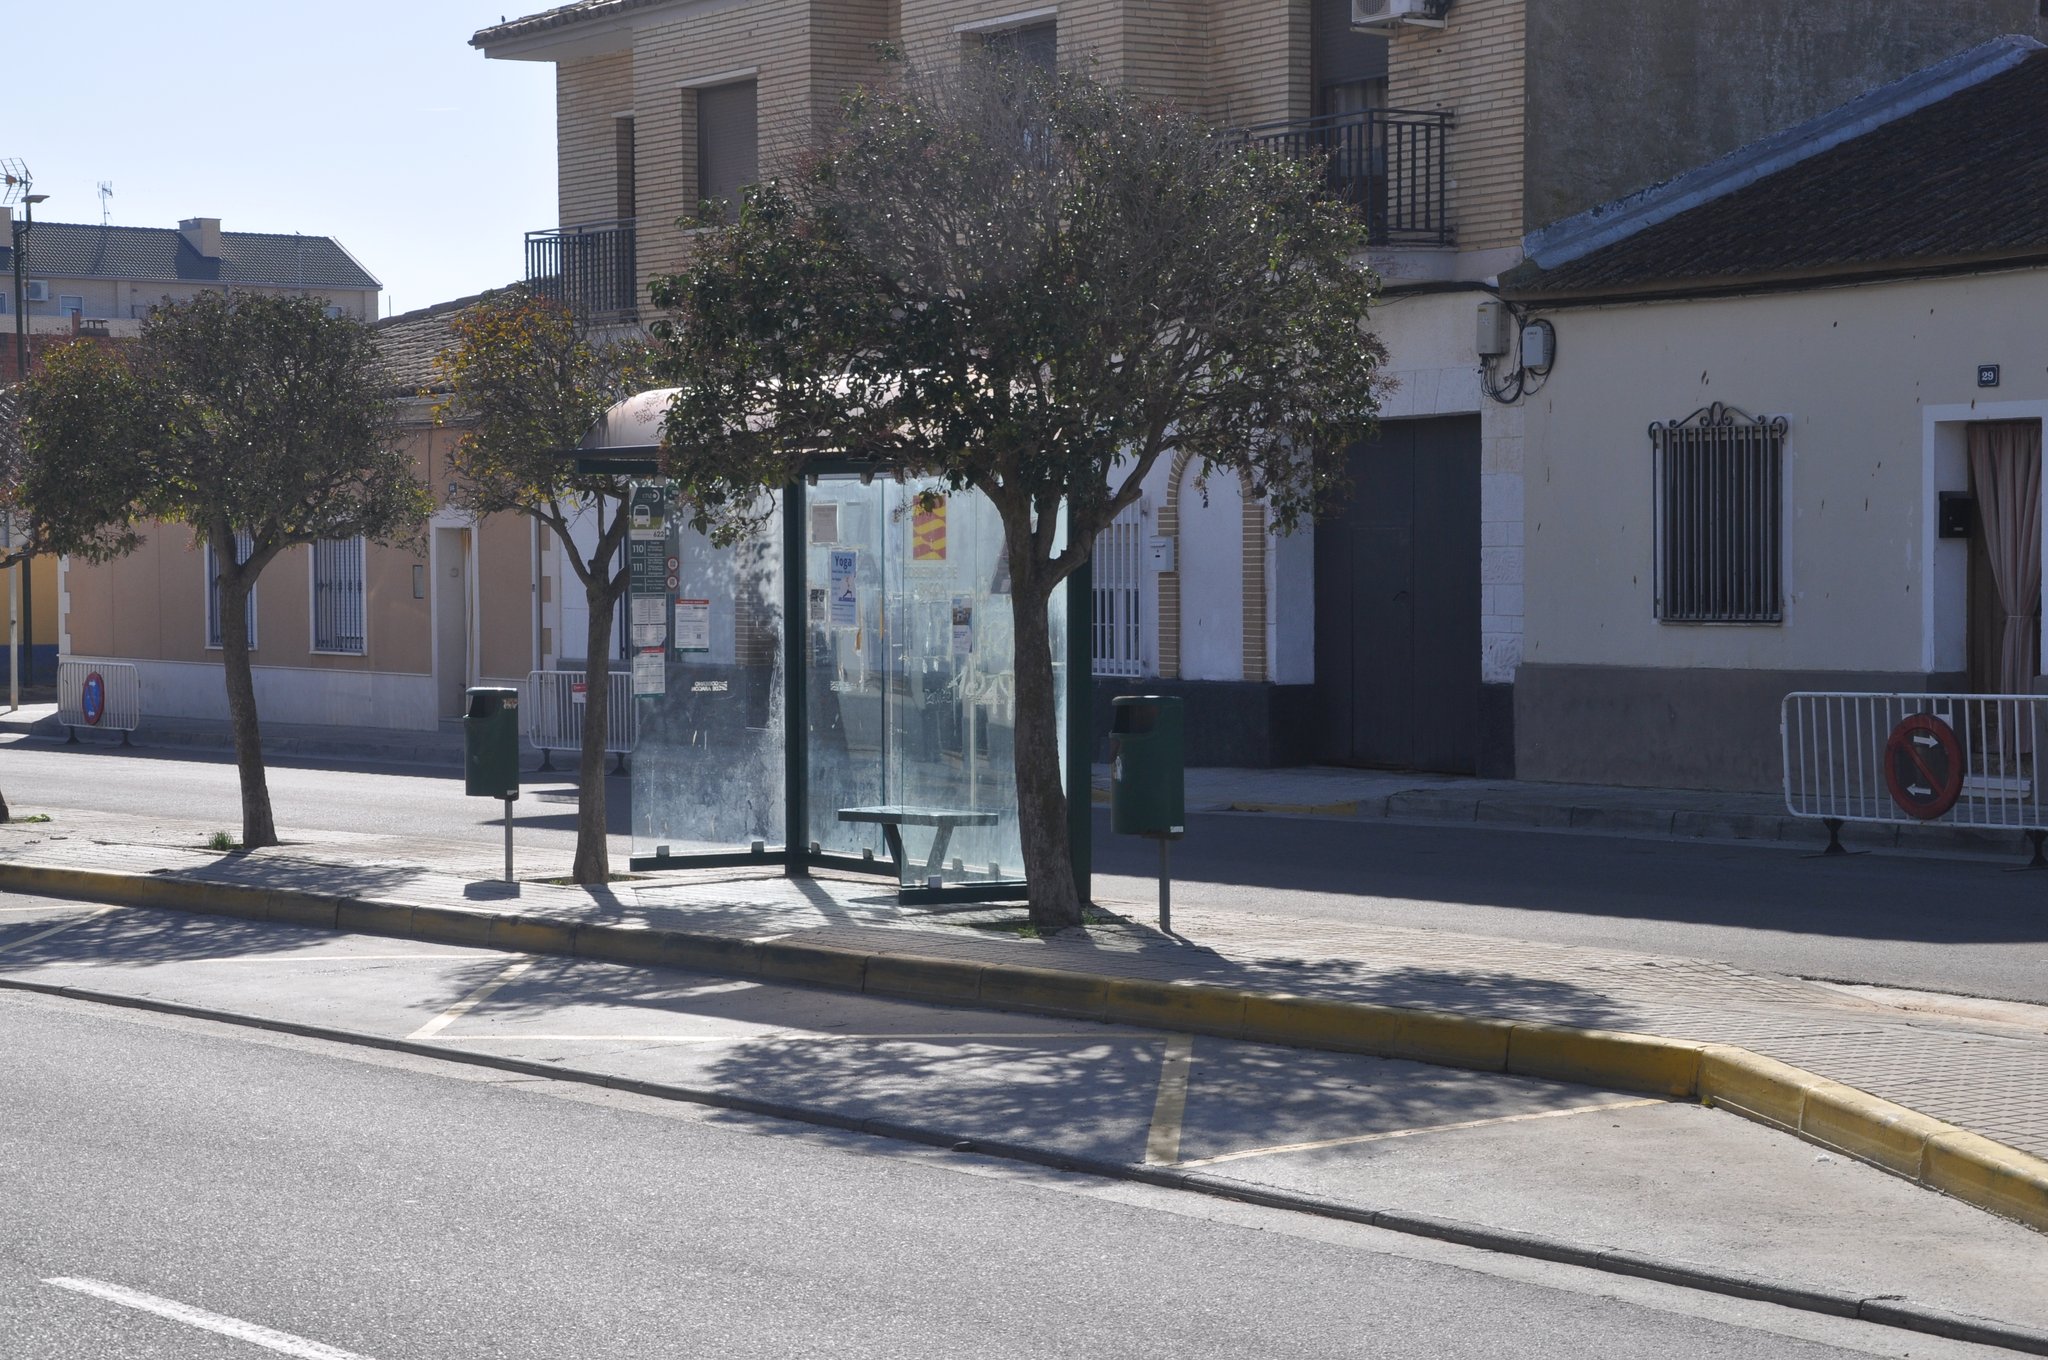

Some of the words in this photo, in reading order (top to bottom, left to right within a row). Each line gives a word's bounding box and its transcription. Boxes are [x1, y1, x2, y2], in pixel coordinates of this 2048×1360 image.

[1982, 371, 1993, 380] 29
[632, 545, 644, 553] 110
[834, 555, 852, 569] Yoga
[632, 563, 643, 571] 111
